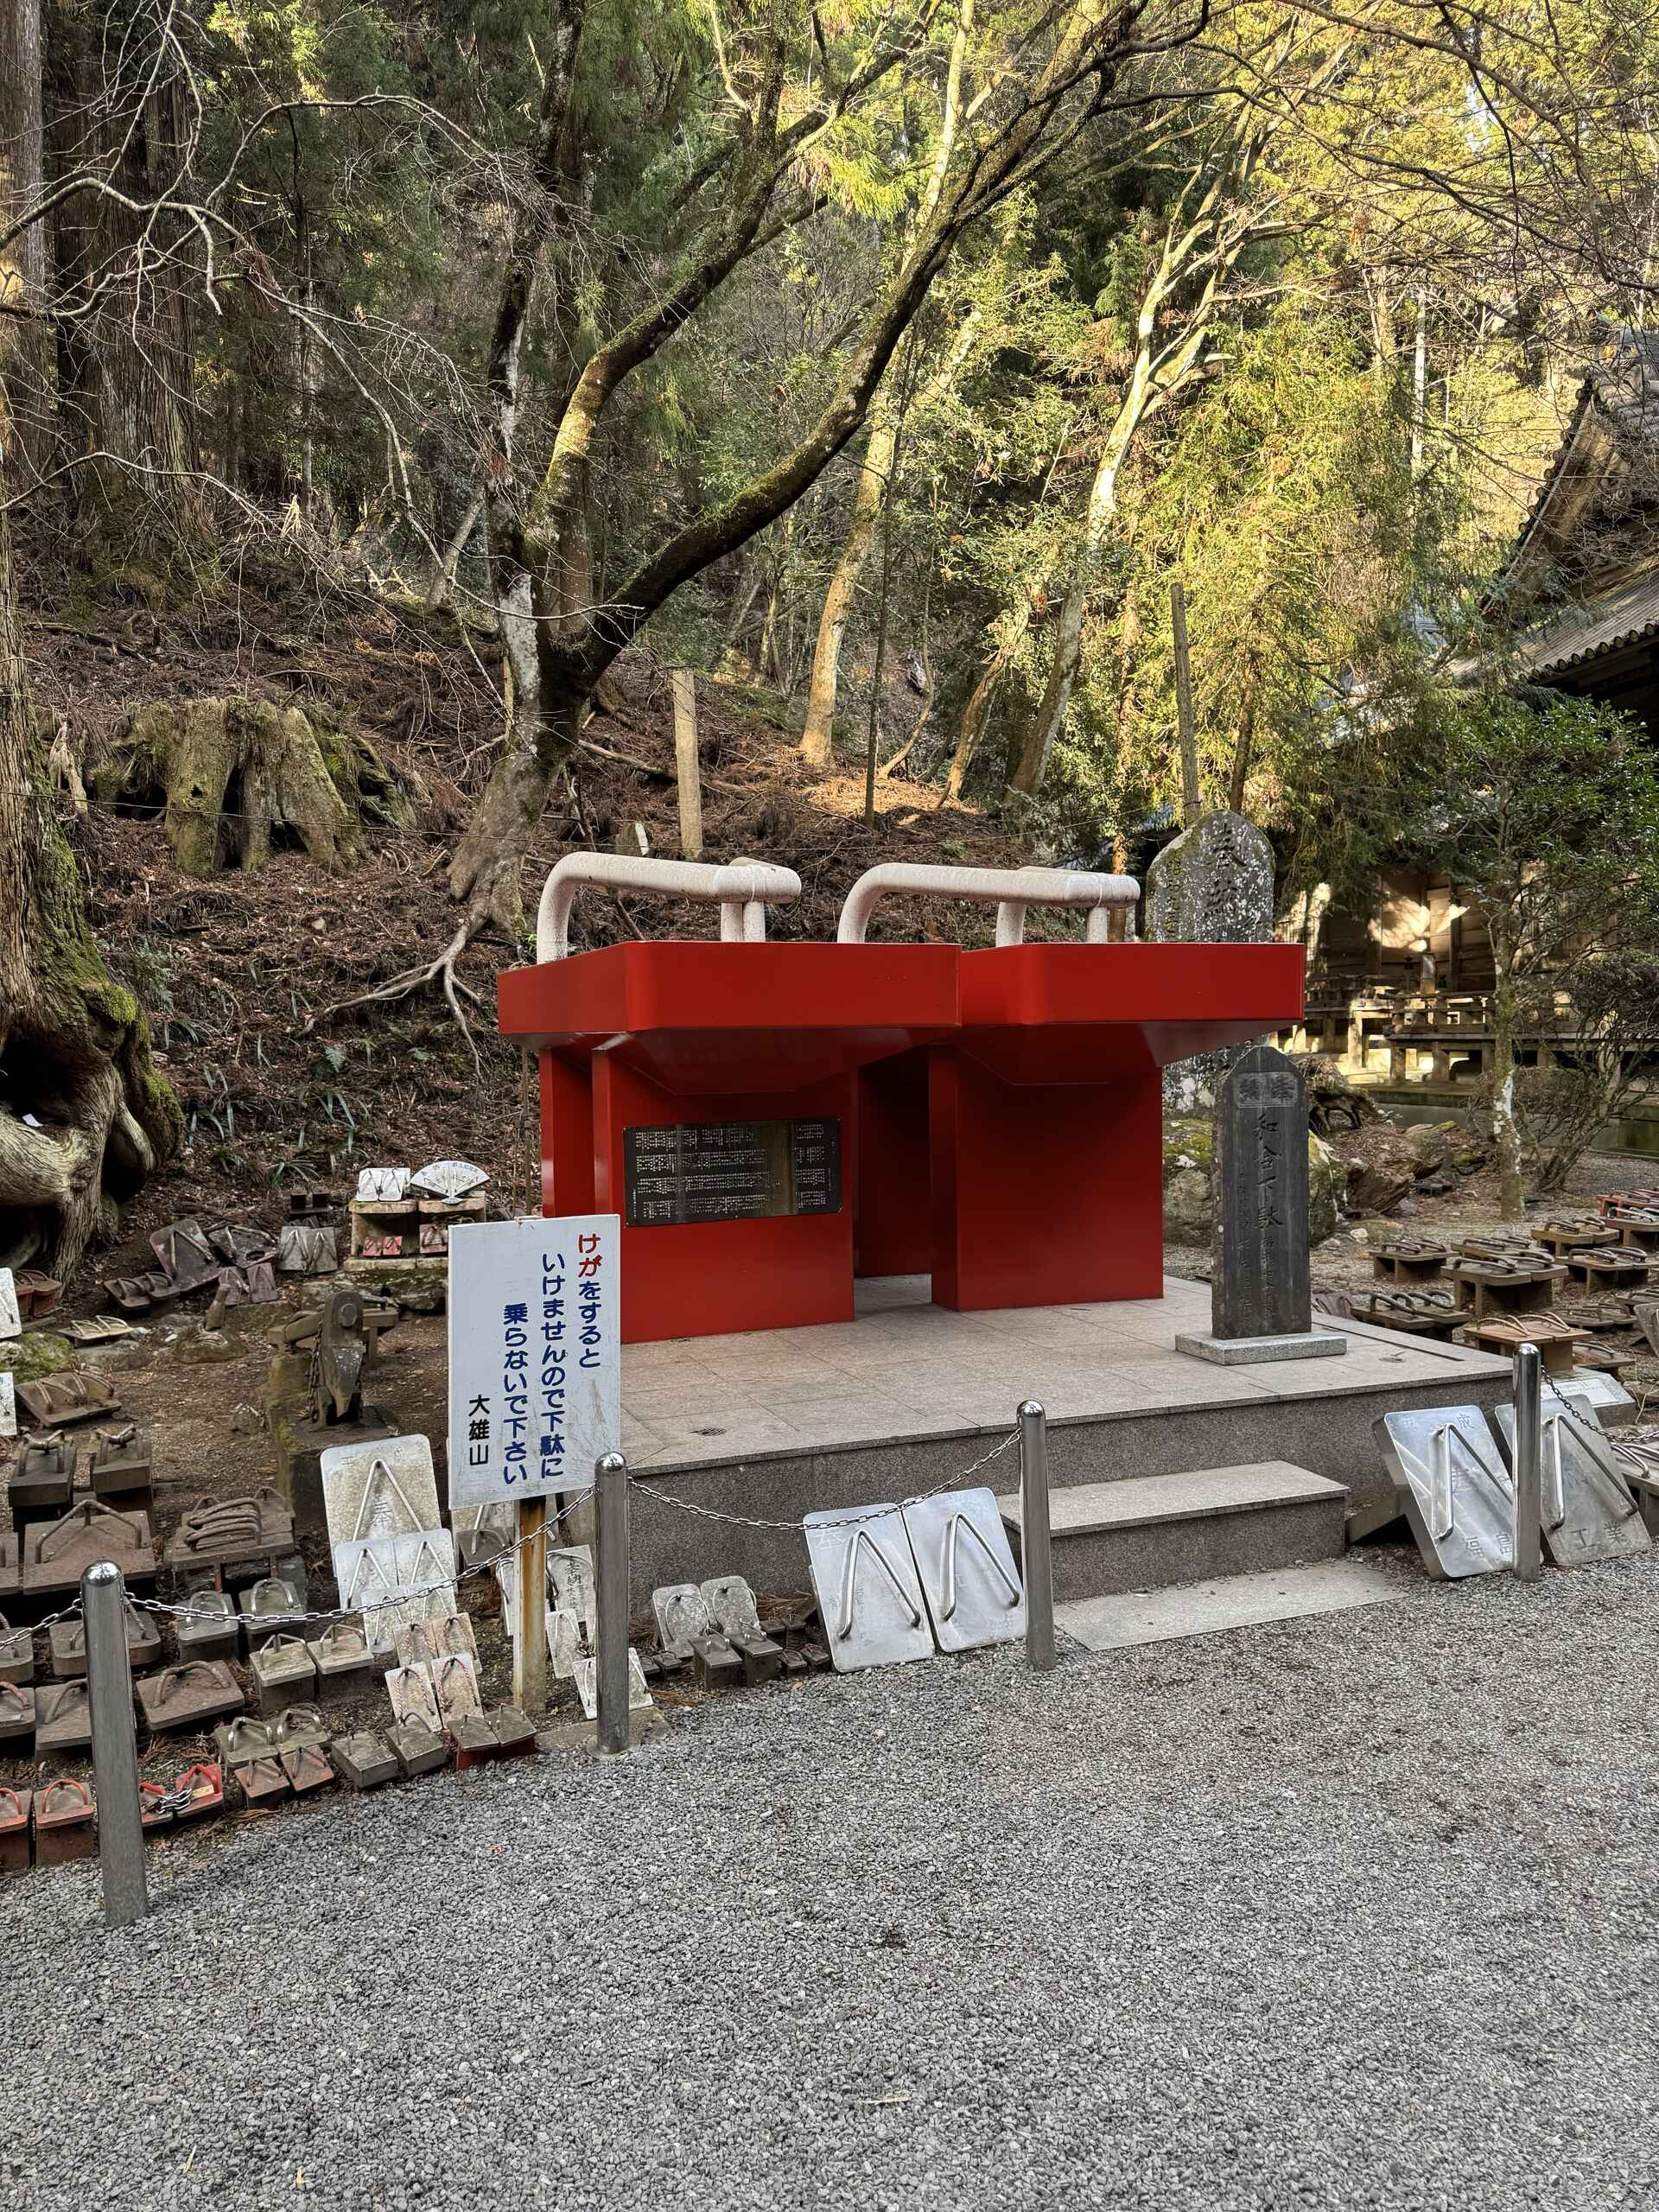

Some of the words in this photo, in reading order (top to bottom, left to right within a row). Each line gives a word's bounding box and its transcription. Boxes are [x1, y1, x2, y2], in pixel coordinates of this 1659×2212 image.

[540, 1252, 566, 1478] いけませんので下駄に
[577, 1233, 603, 1369] けがをすると
[468, 1394, 491, 1466] 大雄山
[503, 1302, 529, 1484] 乗らないで下さい
